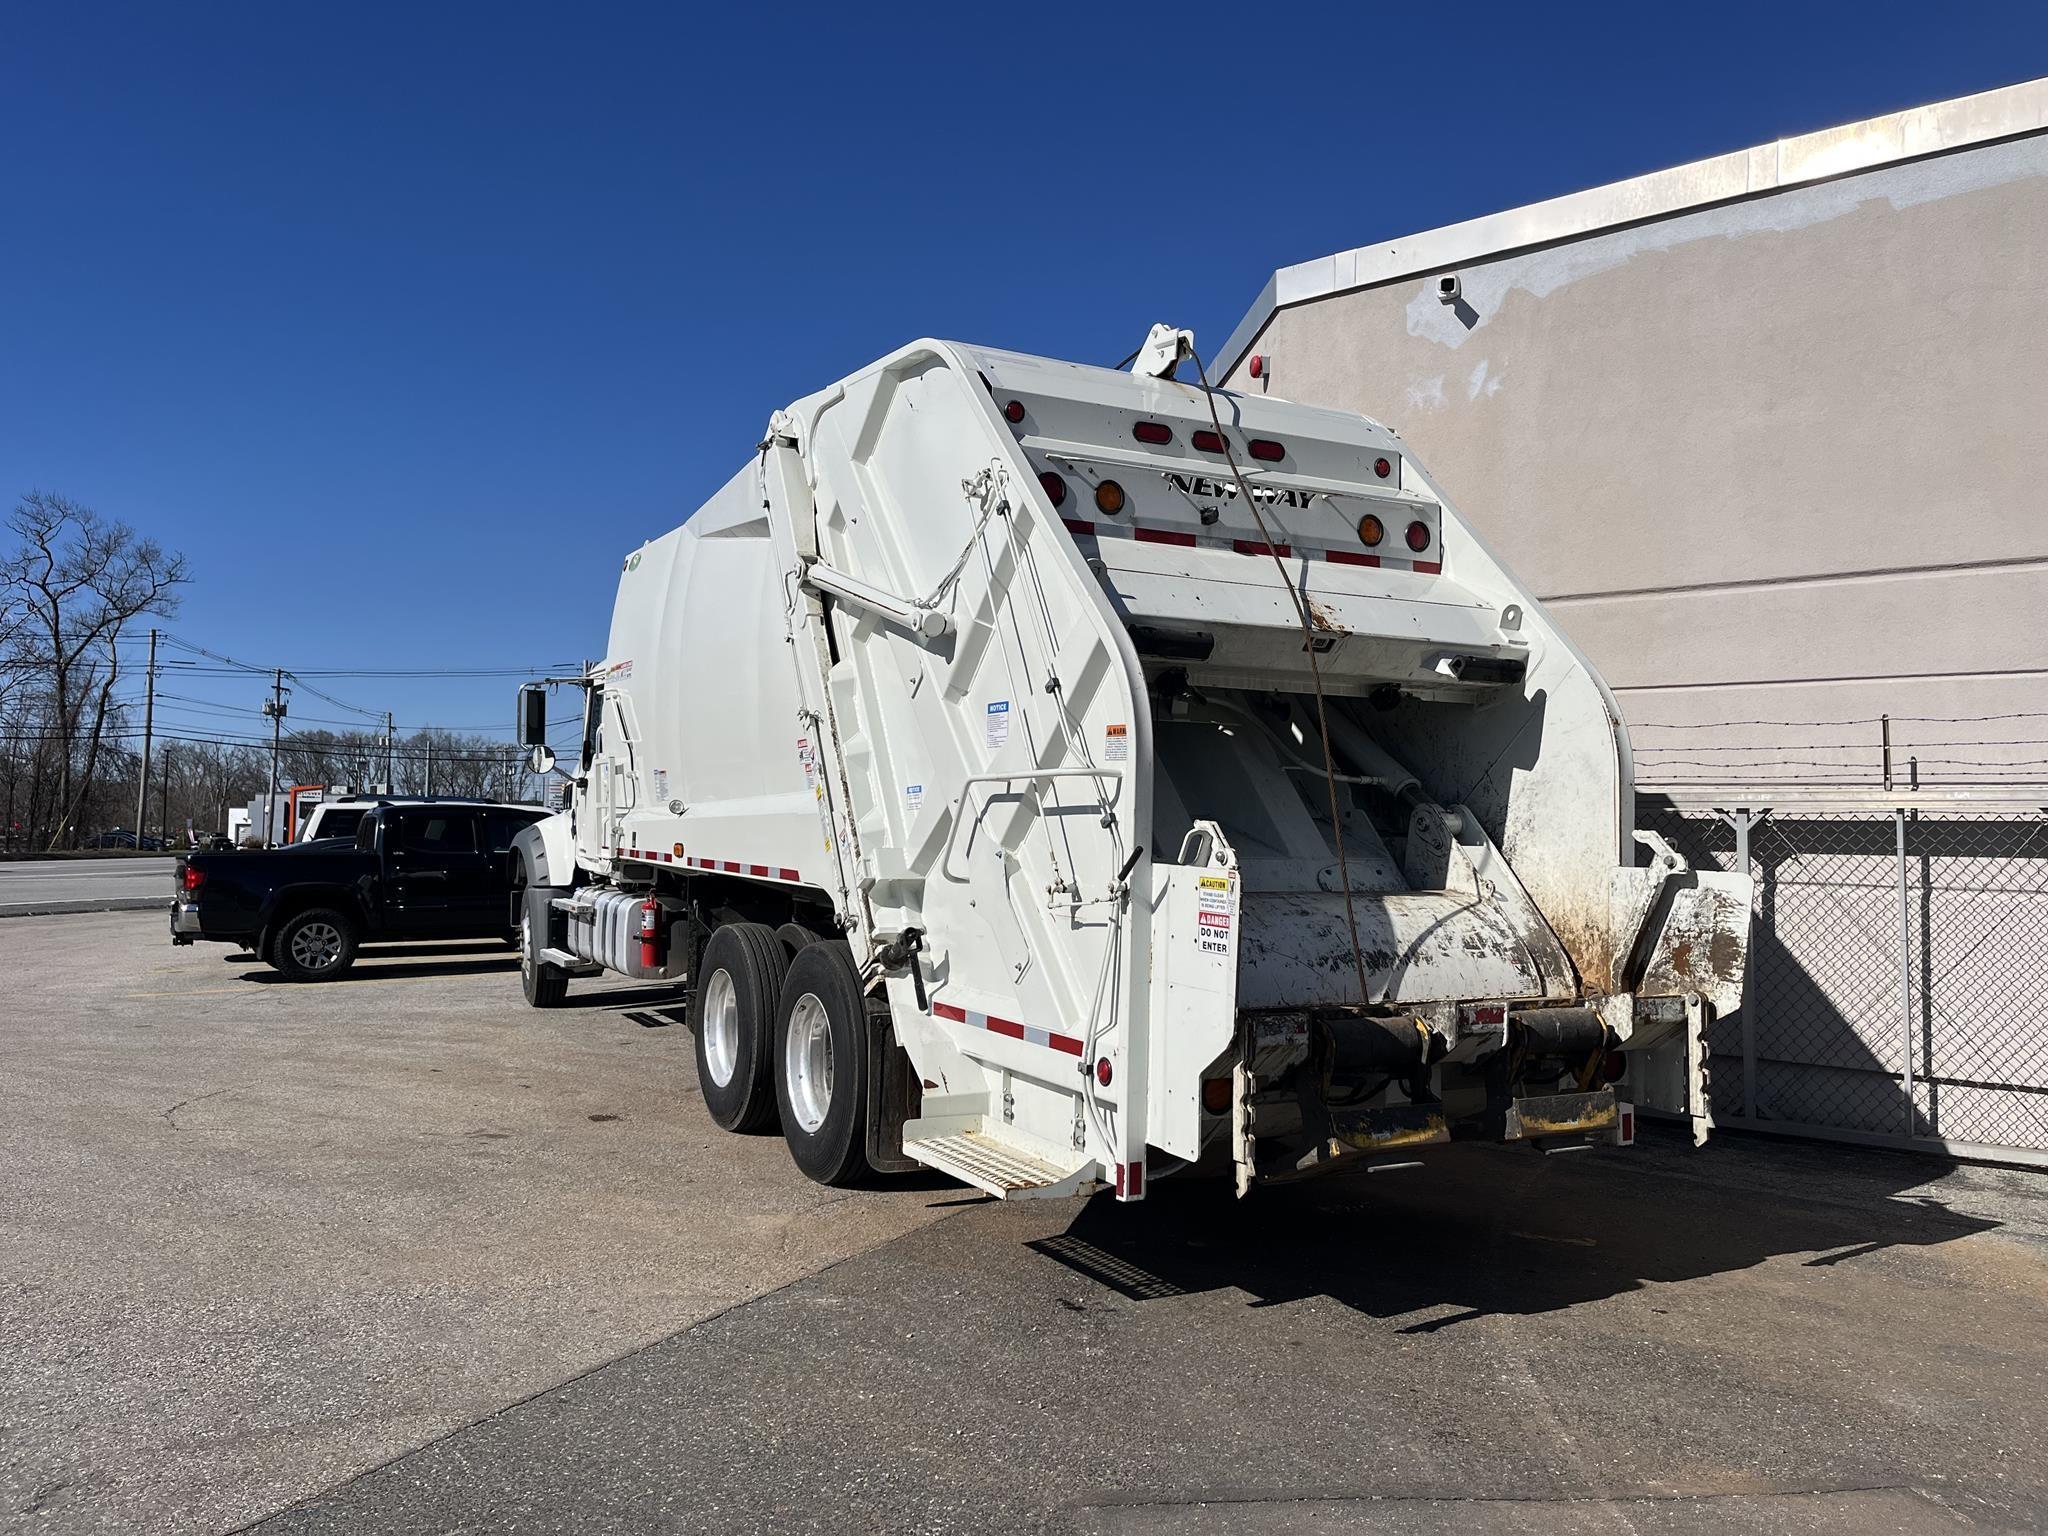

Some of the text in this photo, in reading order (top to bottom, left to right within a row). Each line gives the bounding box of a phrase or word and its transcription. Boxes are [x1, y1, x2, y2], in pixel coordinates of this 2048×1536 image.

[1168, 474, 1317, 509] NEW WAY
[990, 703, 1007, 713] NOTICE
[1205, 879, 1226, 889] CAUTION
[1201, 927, 1229, 940] DO NOT
[1202, 940, 1227, 953] ENTER
